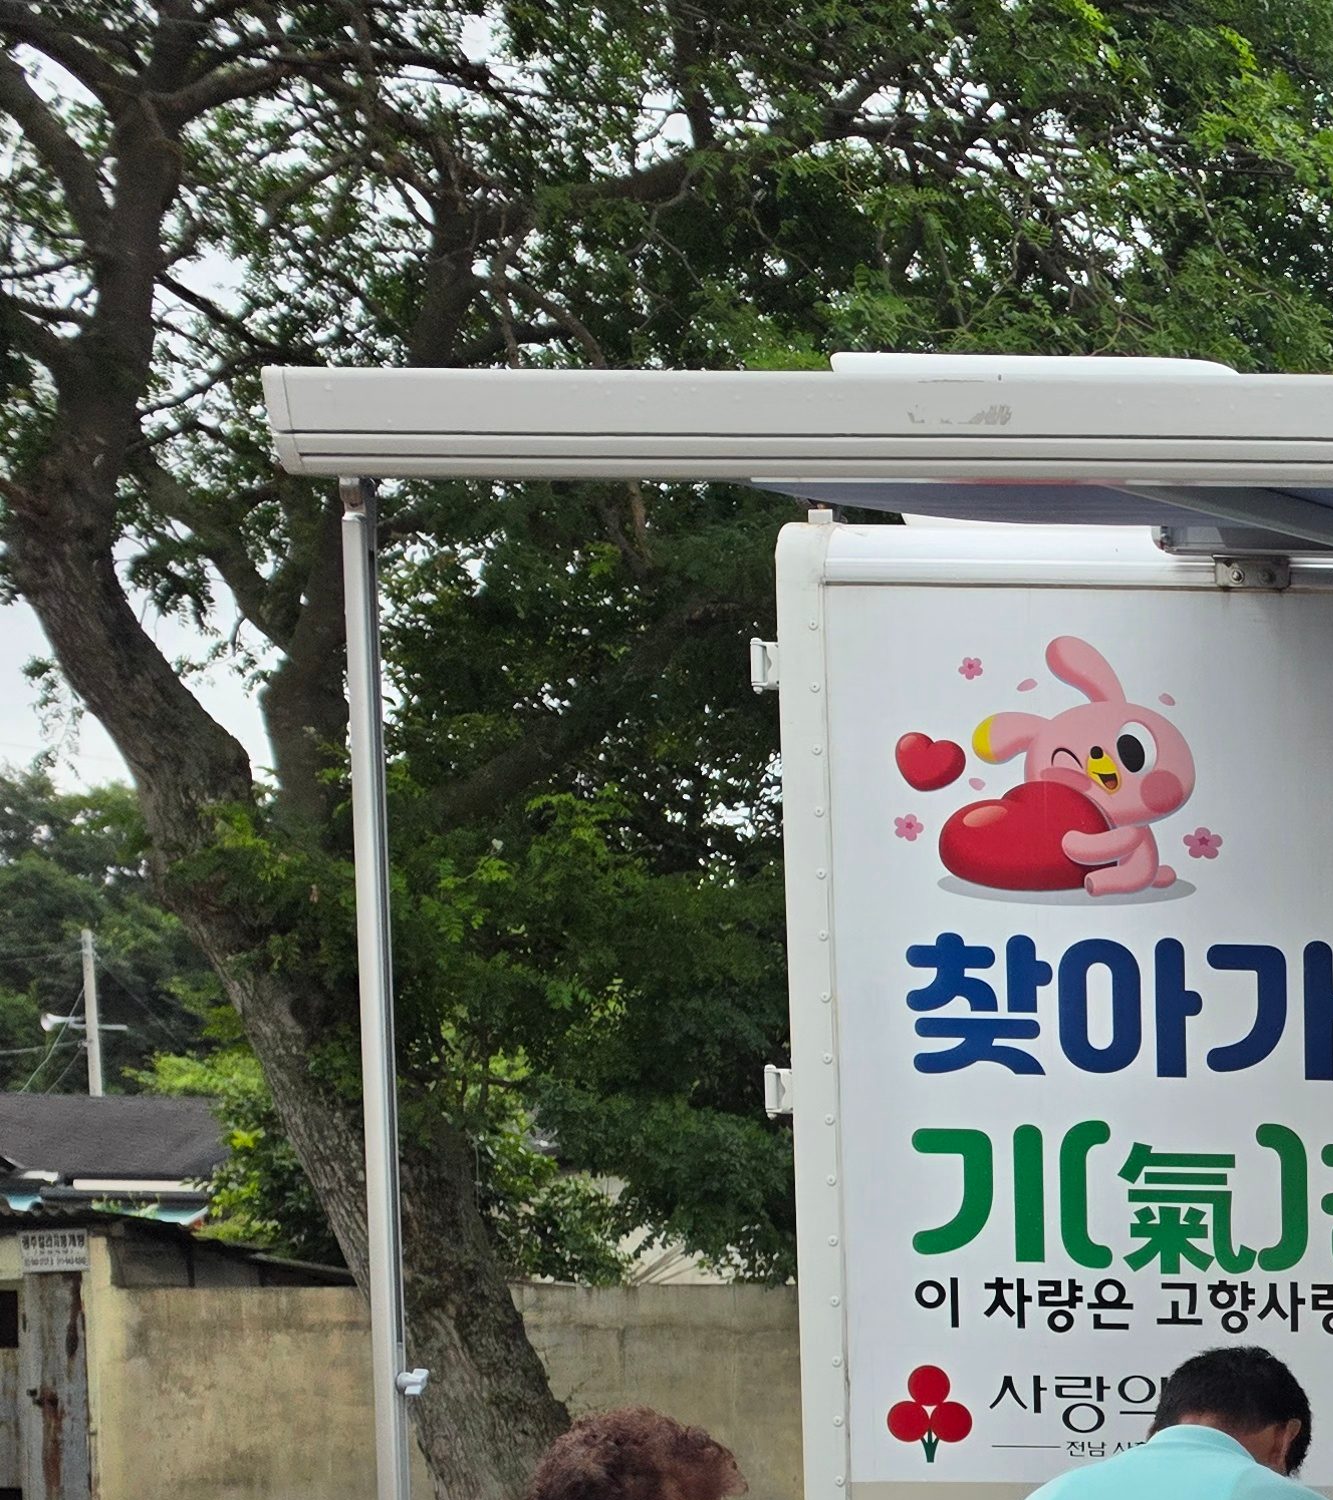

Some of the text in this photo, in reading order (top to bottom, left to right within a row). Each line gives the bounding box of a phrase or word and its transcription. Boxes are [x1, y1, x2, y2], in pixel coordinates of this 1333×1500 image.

[914, 1277, 960, 1329] 이
[983, 1277, 1134, 1334] 차량은
[1066, 1440, 1106, 1458] 전남
